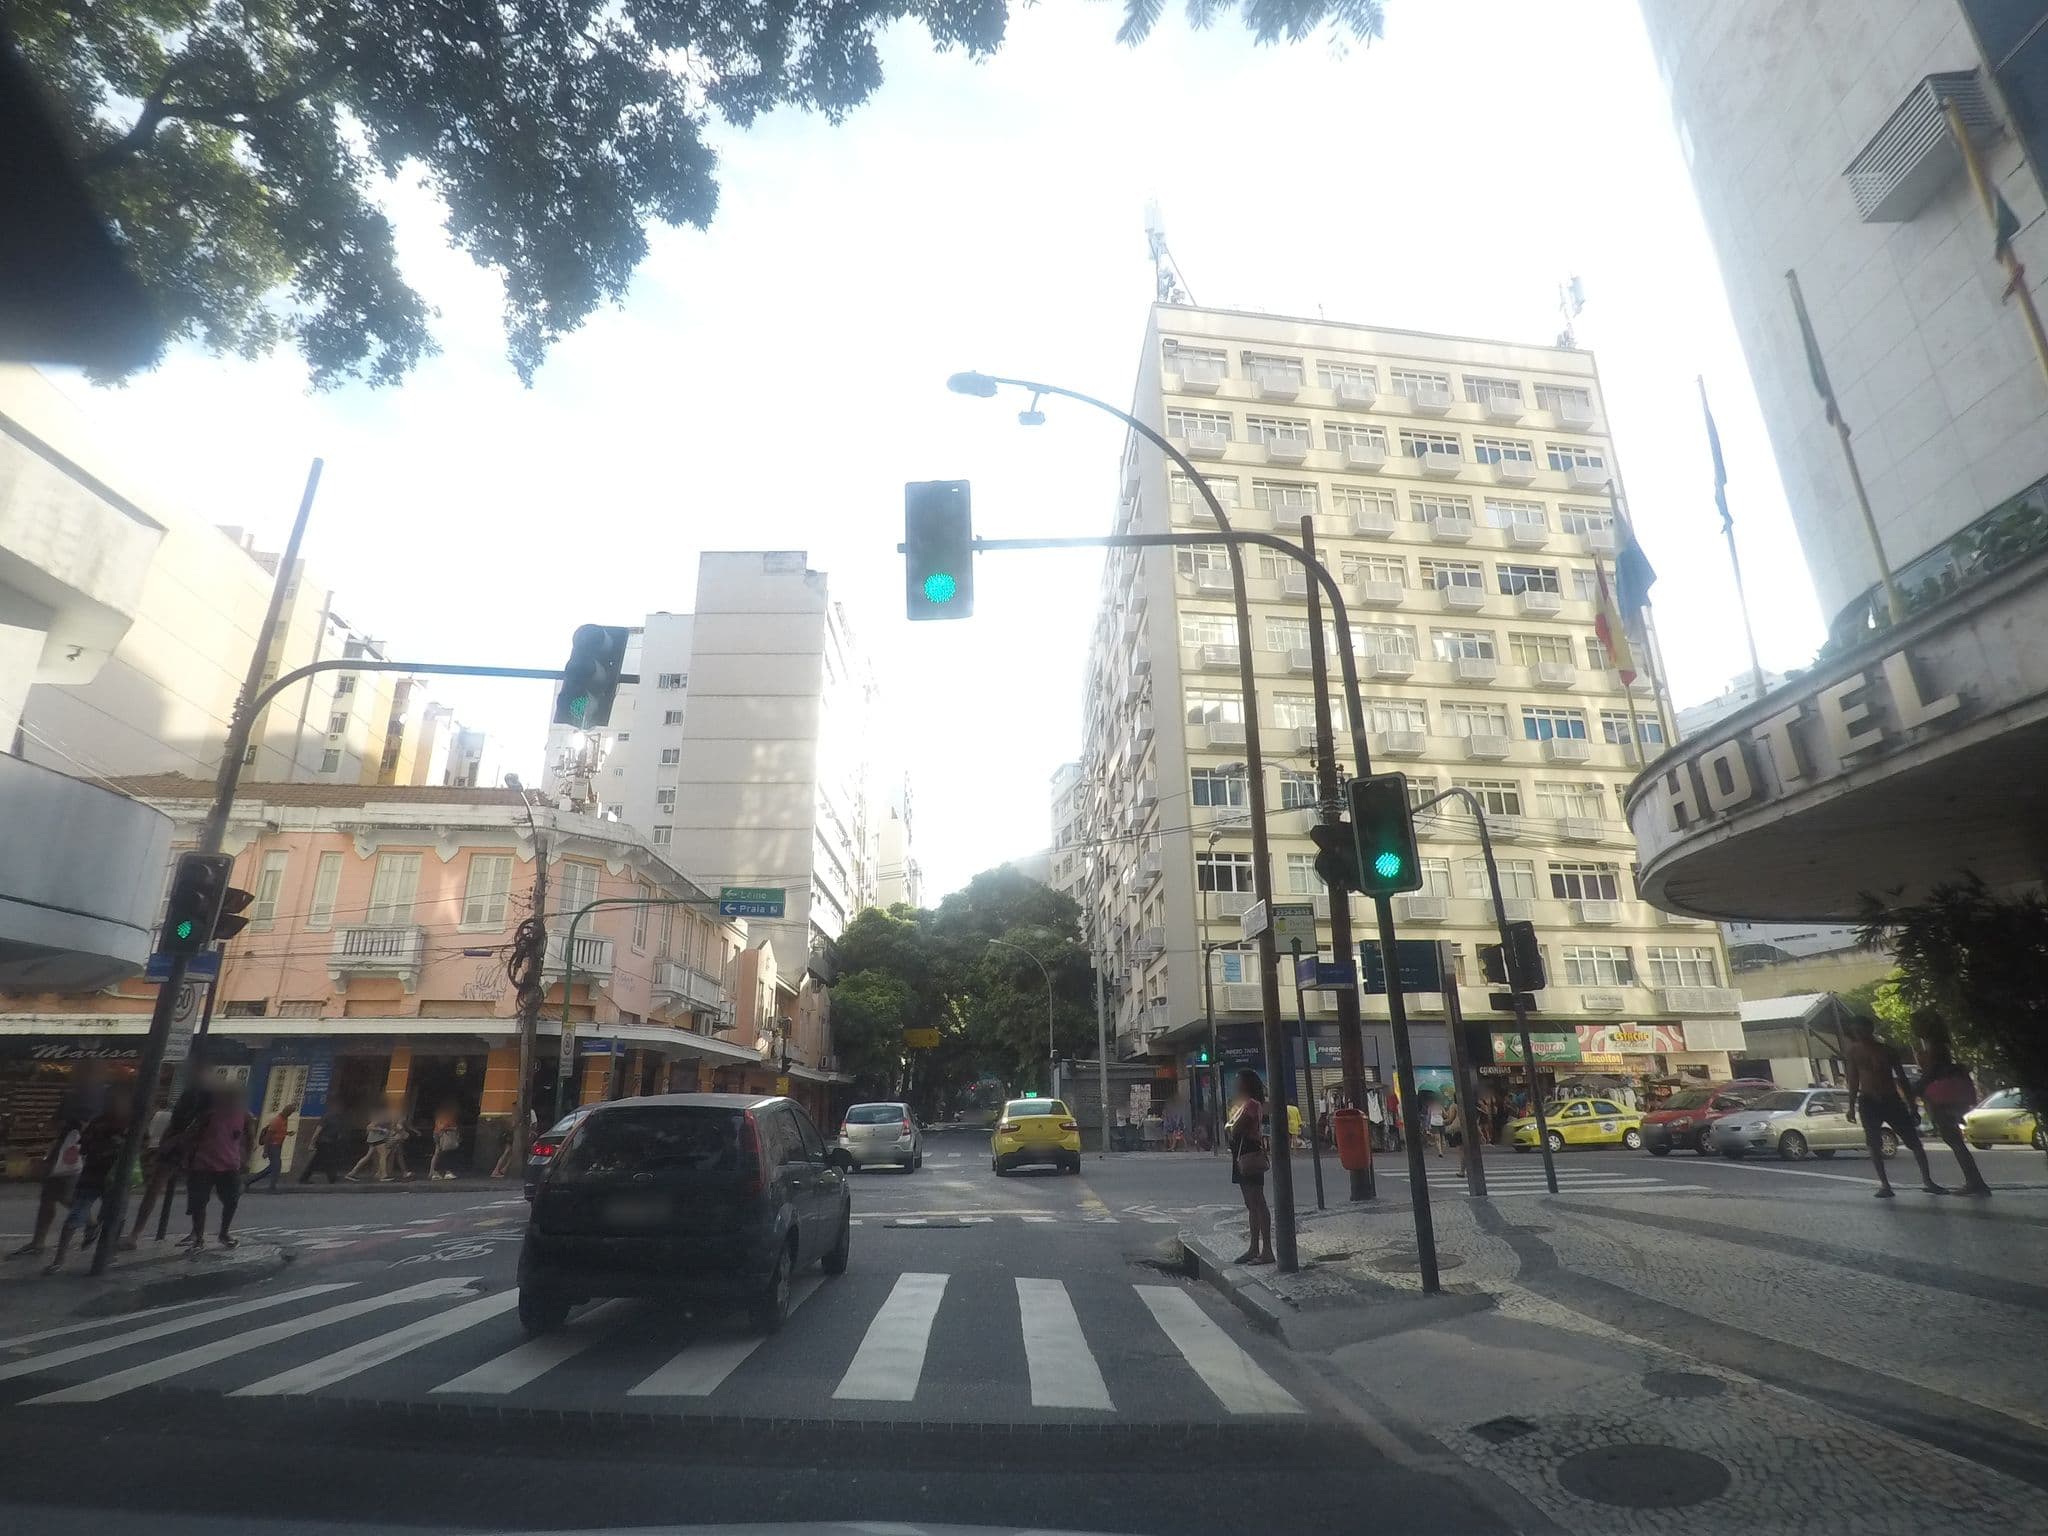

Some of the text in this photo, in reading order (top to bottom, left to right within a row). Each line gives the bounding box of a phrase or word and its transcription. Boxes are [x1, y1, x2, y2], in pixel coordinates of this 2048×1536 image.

[1655, 650, 1962, 834] HOTEL
[739, 904, 766, 913] Praia
[31, 1044, 139, 1059] Marisa
